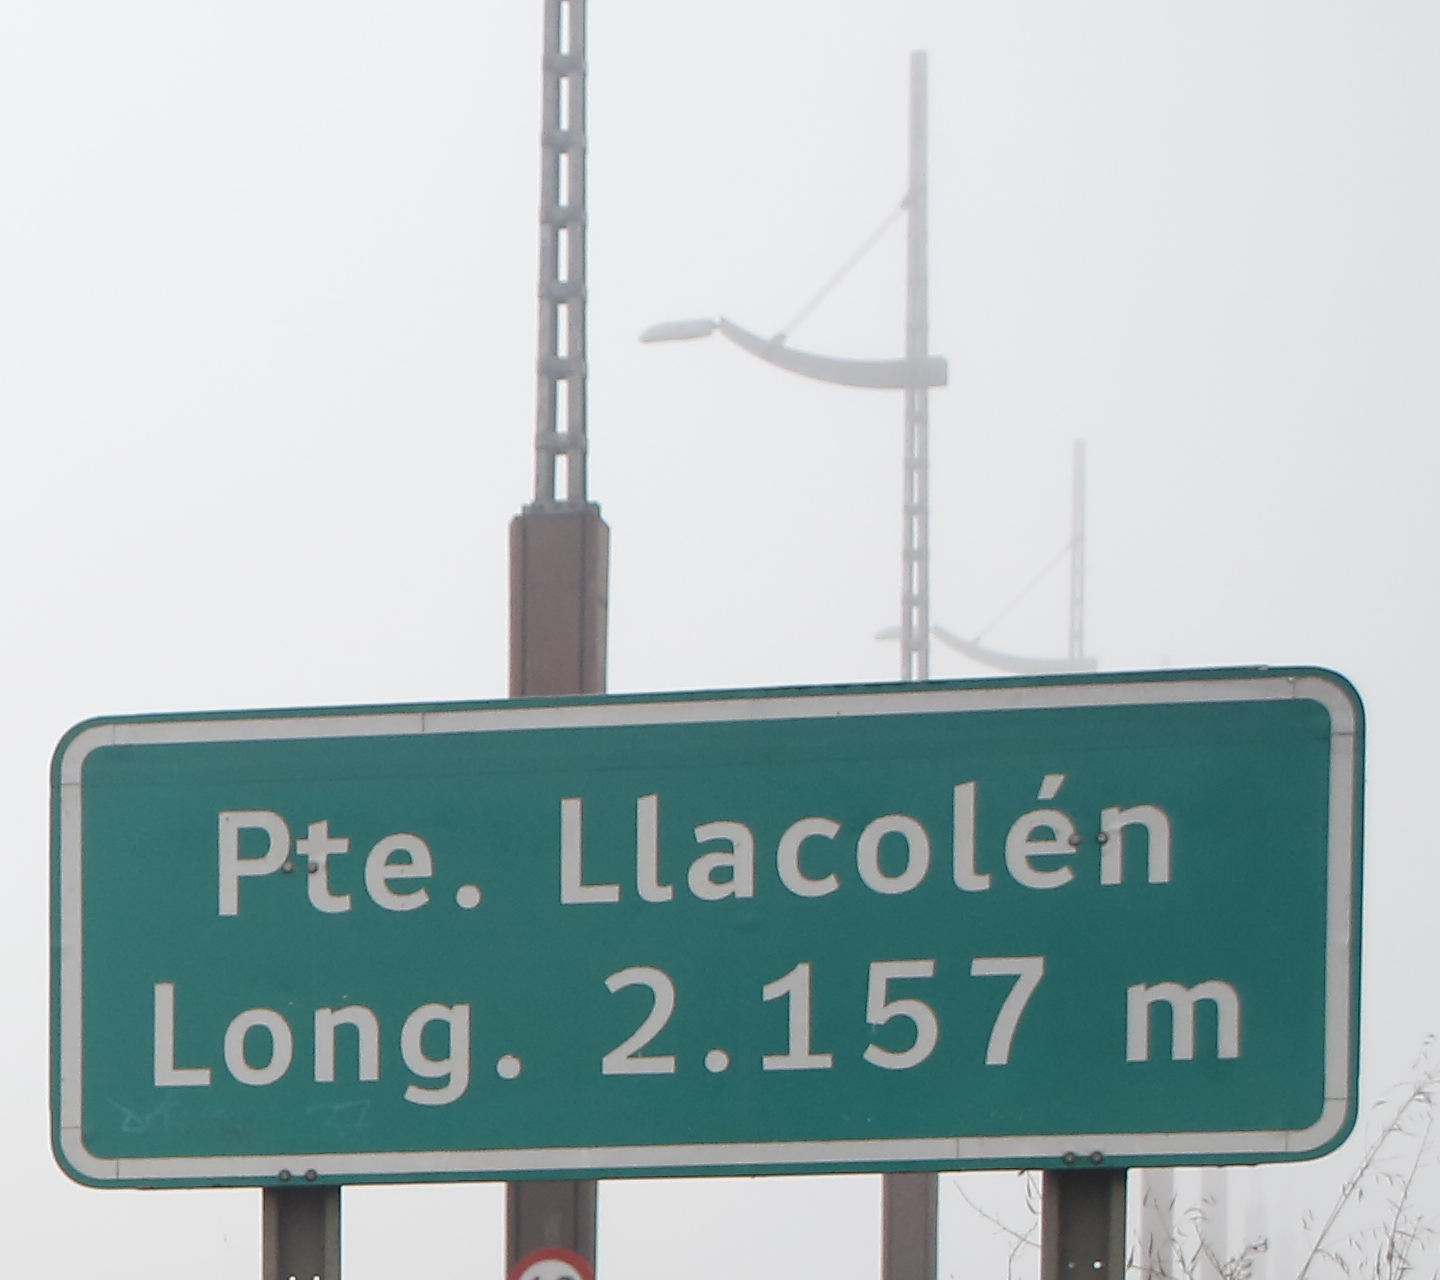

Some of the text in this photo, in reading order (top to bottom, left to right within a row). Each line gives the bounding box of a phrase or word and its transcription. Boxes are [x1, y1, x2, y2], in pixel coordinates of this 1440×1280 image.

[218, 773, 1172, 917] Pte. Llacolén
[153, 955, 1241, 1106] Long. 2.157 m
